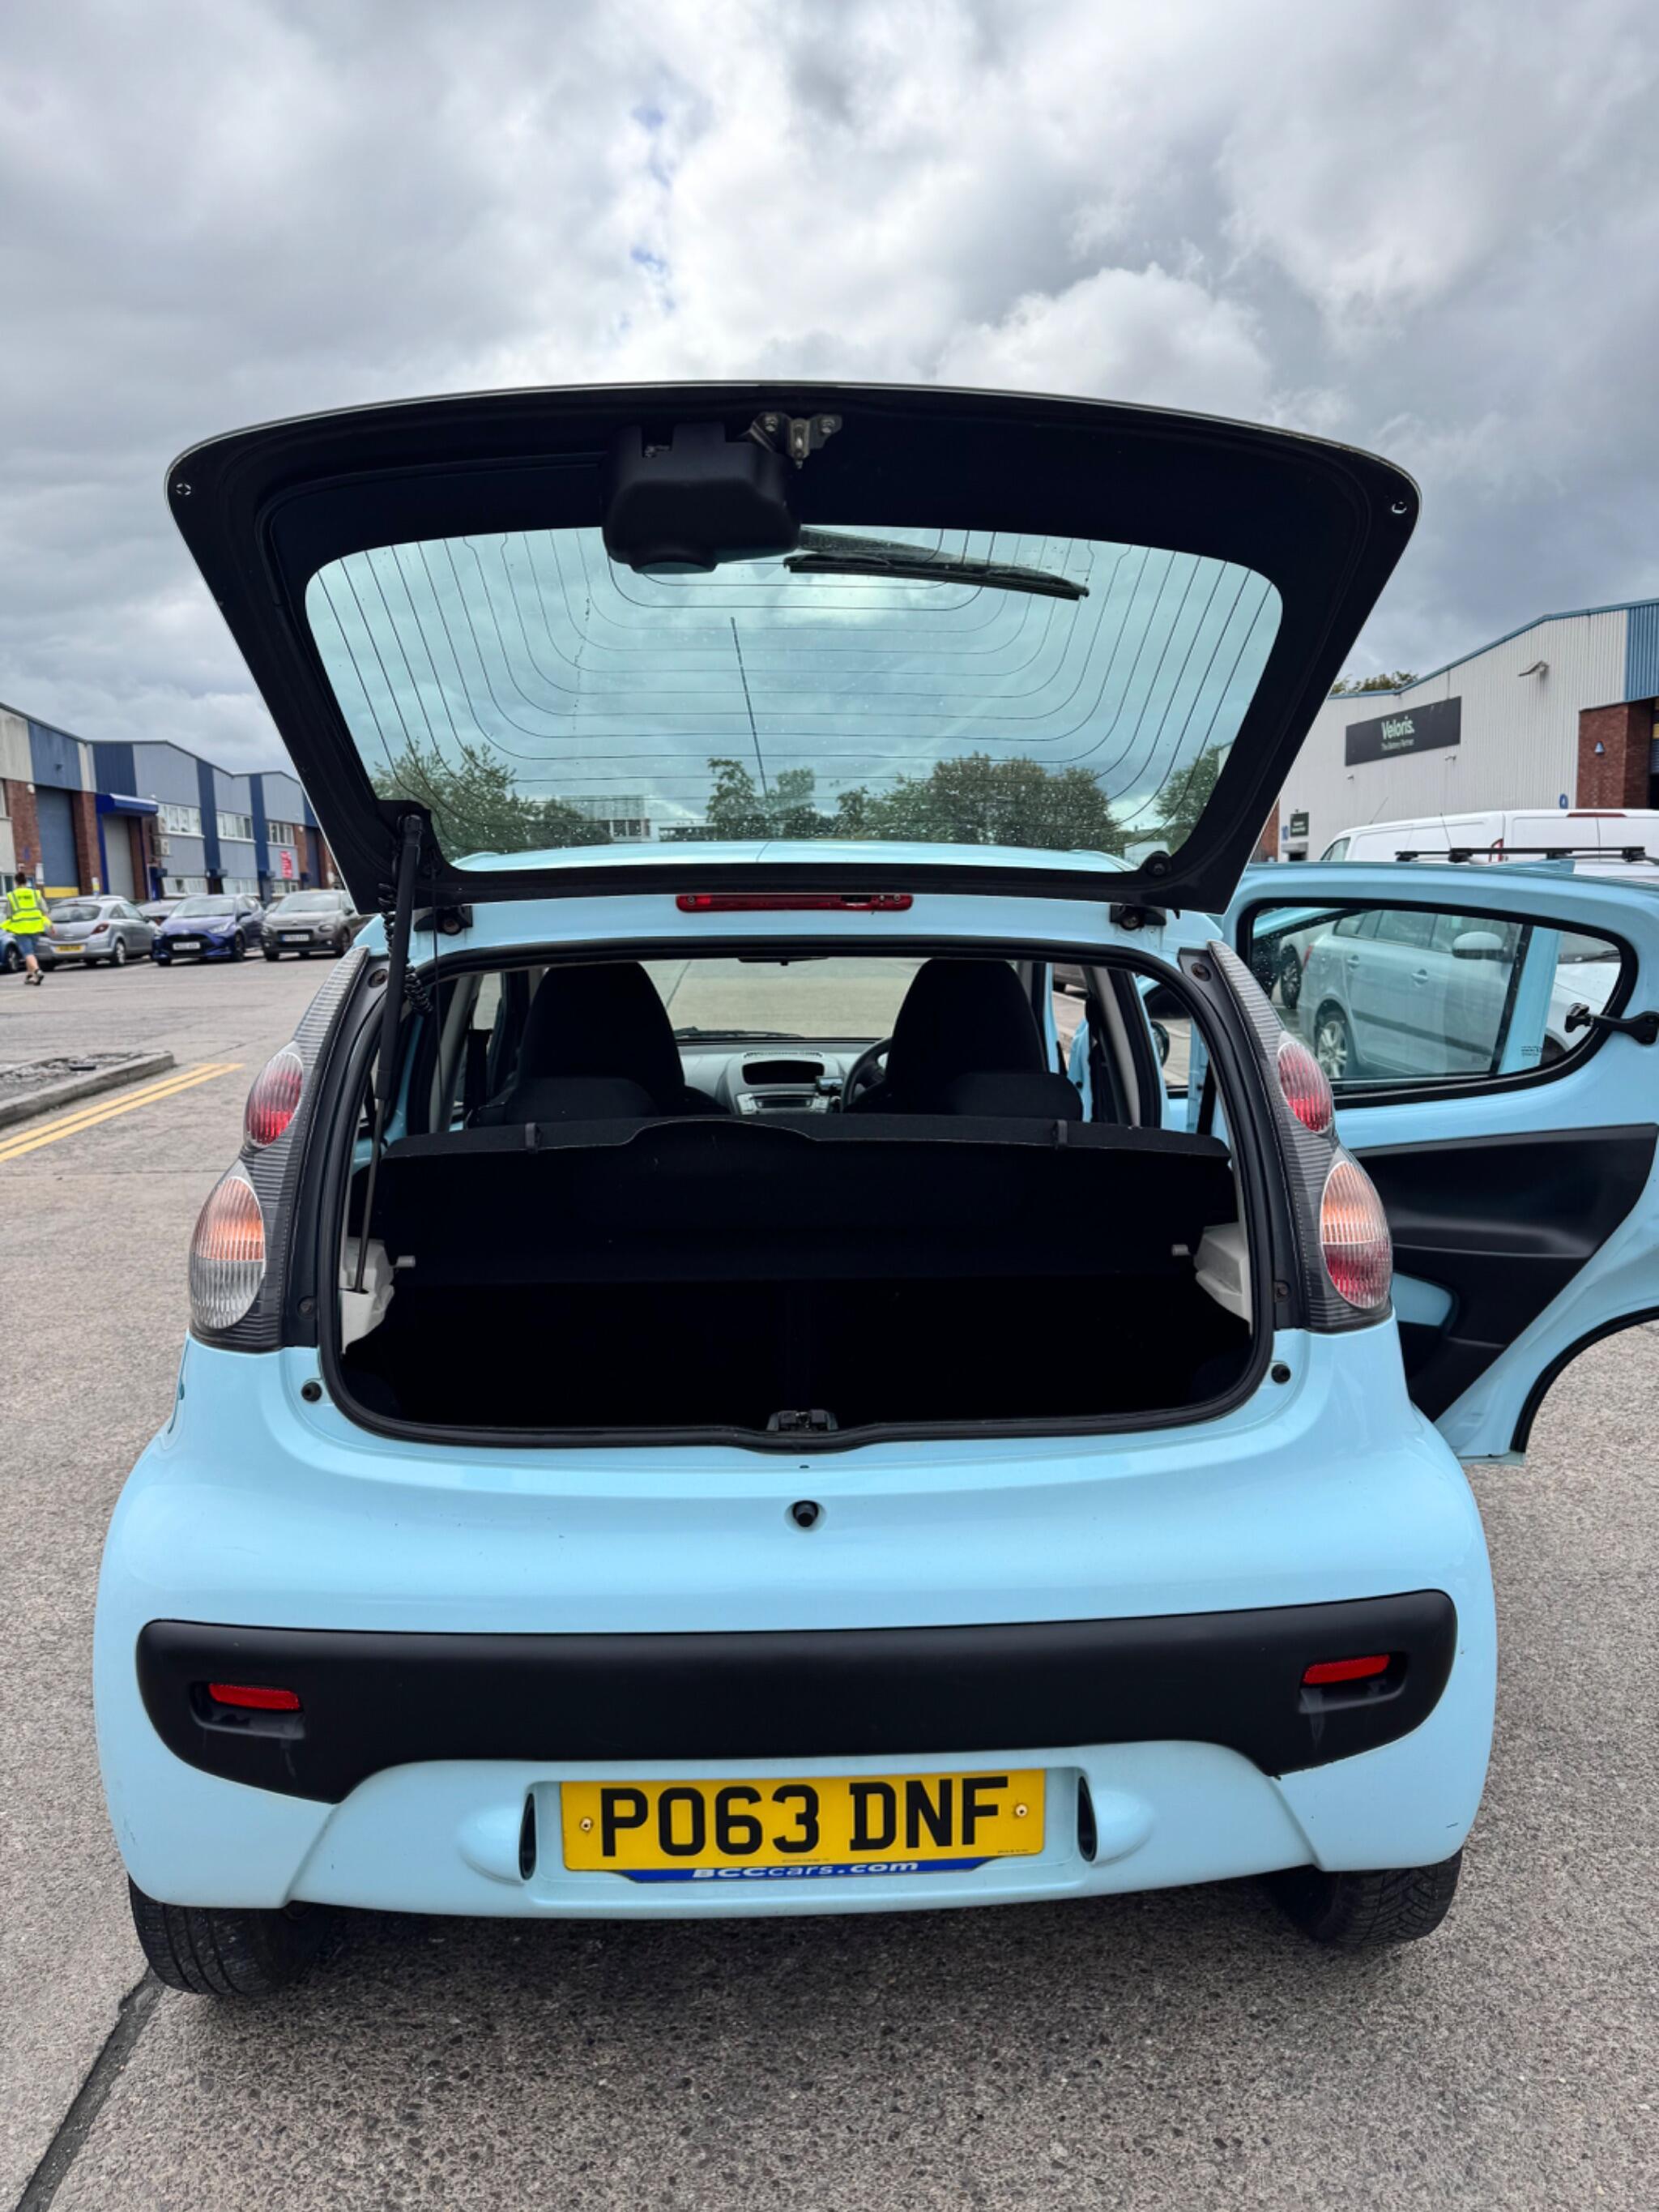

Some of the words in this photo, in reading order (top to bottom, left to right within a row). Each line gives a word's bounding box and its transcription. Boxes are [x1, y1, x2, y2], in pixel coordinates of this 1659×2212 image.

[601, 1785, 819, 1856] PO63
[850, 1776, 1008, 1851] DNF
[693, 1862, 918, 1878] BCCcars.com
